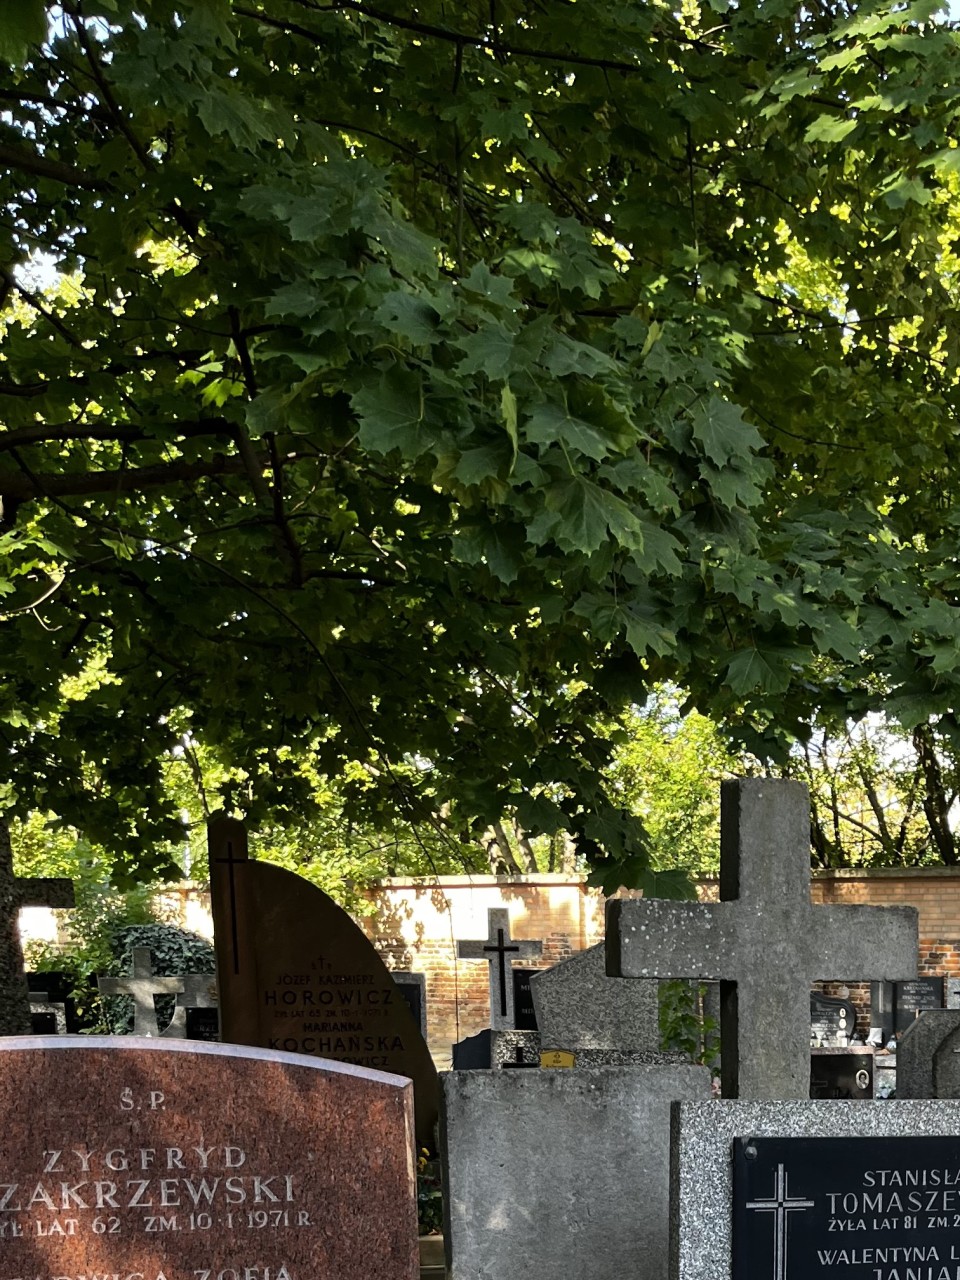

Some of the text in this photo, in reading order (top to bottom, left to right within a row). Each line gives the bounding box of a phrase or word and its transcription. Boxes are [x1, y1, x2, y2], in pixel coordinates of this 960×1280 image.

[276, 973, 375, 986] JÓZEF KAZIMIERZ
[264, 990, 394, 1006] HOROWICZ
[303, 1022, 364, 1033] MARIANNA
[268, 1035, 406, 1053] KOCHAŃSKA
[43, 1146, 246, 1173] ZYGFRYD
[0, 1174, 295, 1212] ZAKRZEWSKI
[36, 1218, 79, 1237] LAT
[92, 1215, 122, 1234] 62
[144, 1213, 183, 1233] ZM.
[828, 1216, 868, 1232] ŻYŁA
[873, 1217, 900, 1231] LAT
[904, 1215, 918, 1230] 81
[927, 1216, 951, 1229] ZM.
[816, 1245, 940, 1266] WALENTYNA
